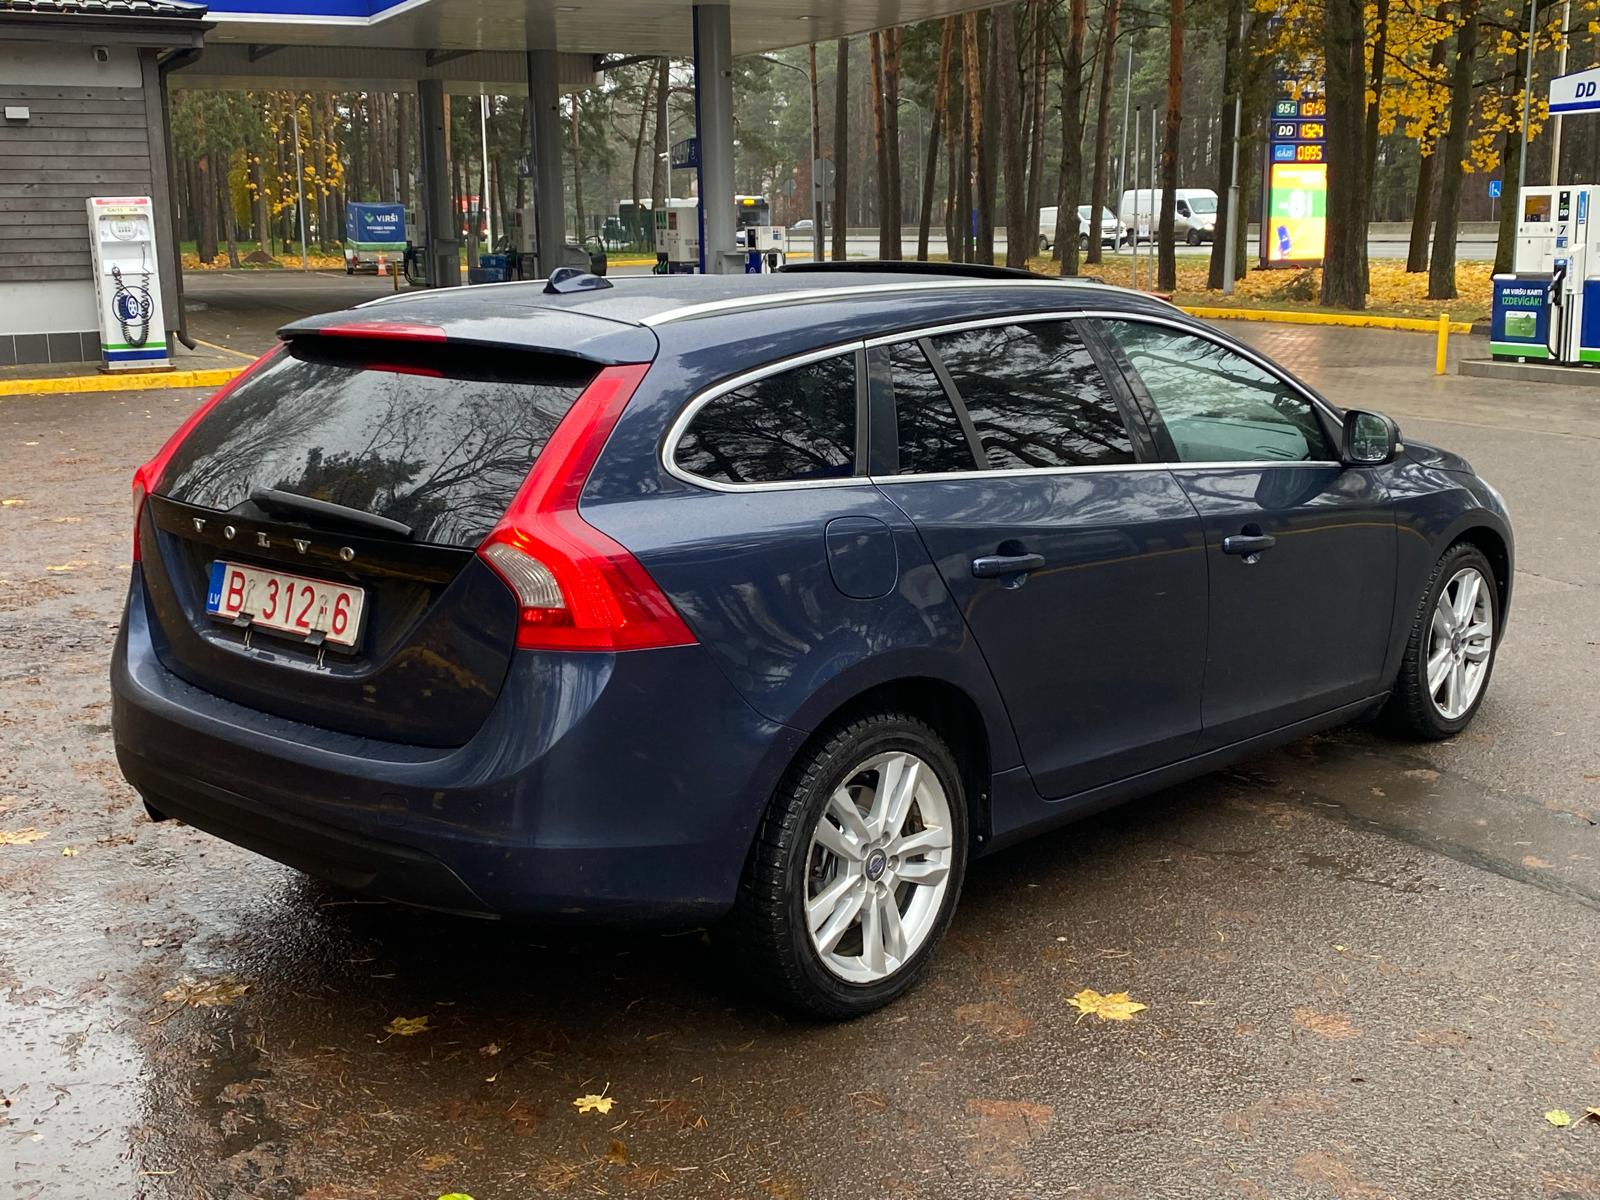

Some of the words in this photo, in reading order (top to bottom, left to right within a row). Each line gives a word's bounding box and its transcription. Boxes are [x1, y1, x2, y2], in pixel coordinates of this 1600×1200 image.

[1575, 81, 1597, 98] DD
[1278, 125, 1294, 136] DD
[376, 213, 398, 222] VIRŠI
[1559, 224, 1567, 235] 7
[192, 517, 355, 562] VOLVO
[209, 592, 221, 605] LV
